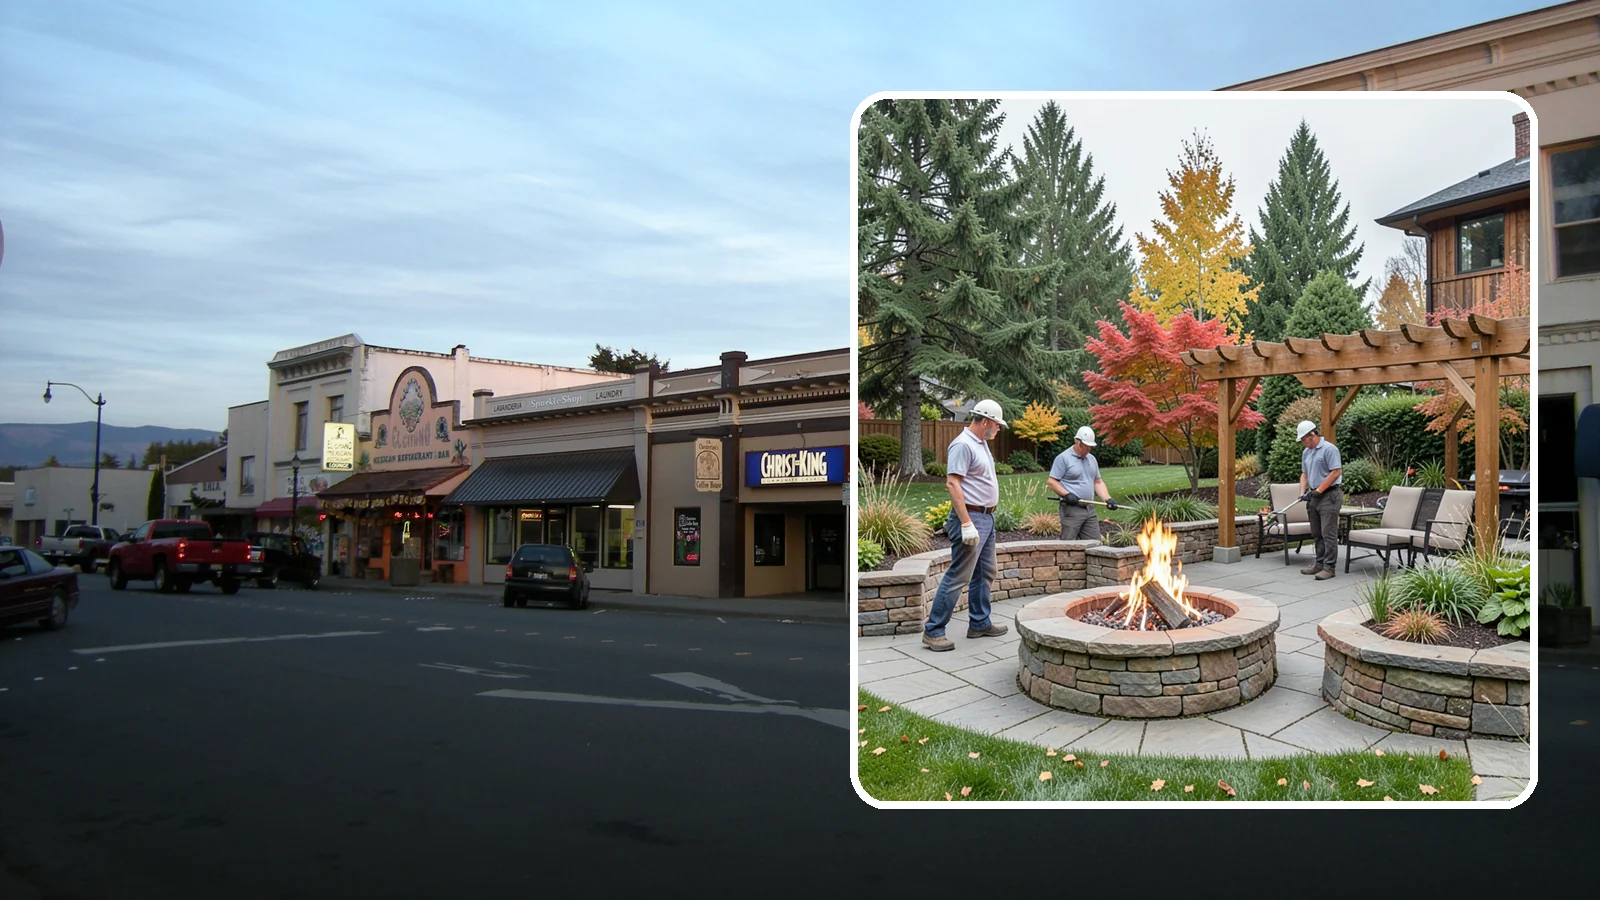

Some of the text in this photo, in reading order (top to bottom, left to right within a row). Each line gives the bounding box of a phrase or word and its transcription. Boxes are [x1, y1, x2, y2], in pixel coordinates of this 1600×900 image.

[596, 388, 623, 400] LAUNDRY
[493, 402, 522, 412] LAVANDERIA
[397, 451, 433, 462] RESTAURANT
[438, 450, 450, 459] BAR
[761, 450, 827, 478] CHRIST KING
